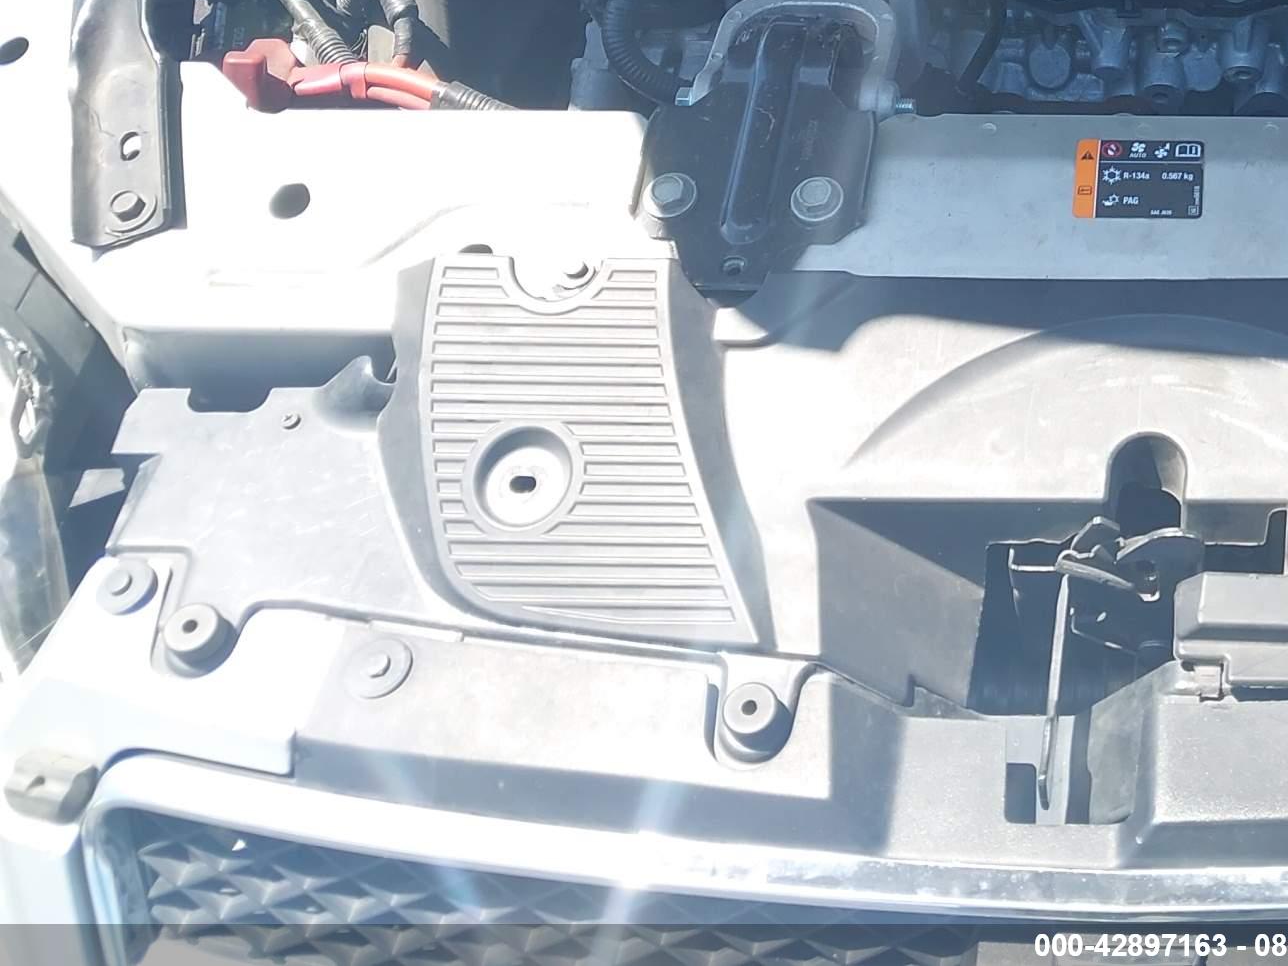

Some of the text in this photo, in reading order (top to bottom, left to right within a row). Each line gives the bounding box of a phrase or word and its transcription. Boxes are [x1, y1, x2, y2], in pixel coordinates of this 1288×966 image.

[1123, 172, 1150, 180] R-134a
[1183, 172, 1194, 181] kg
[1122, 196, 1139, 205] PAG
